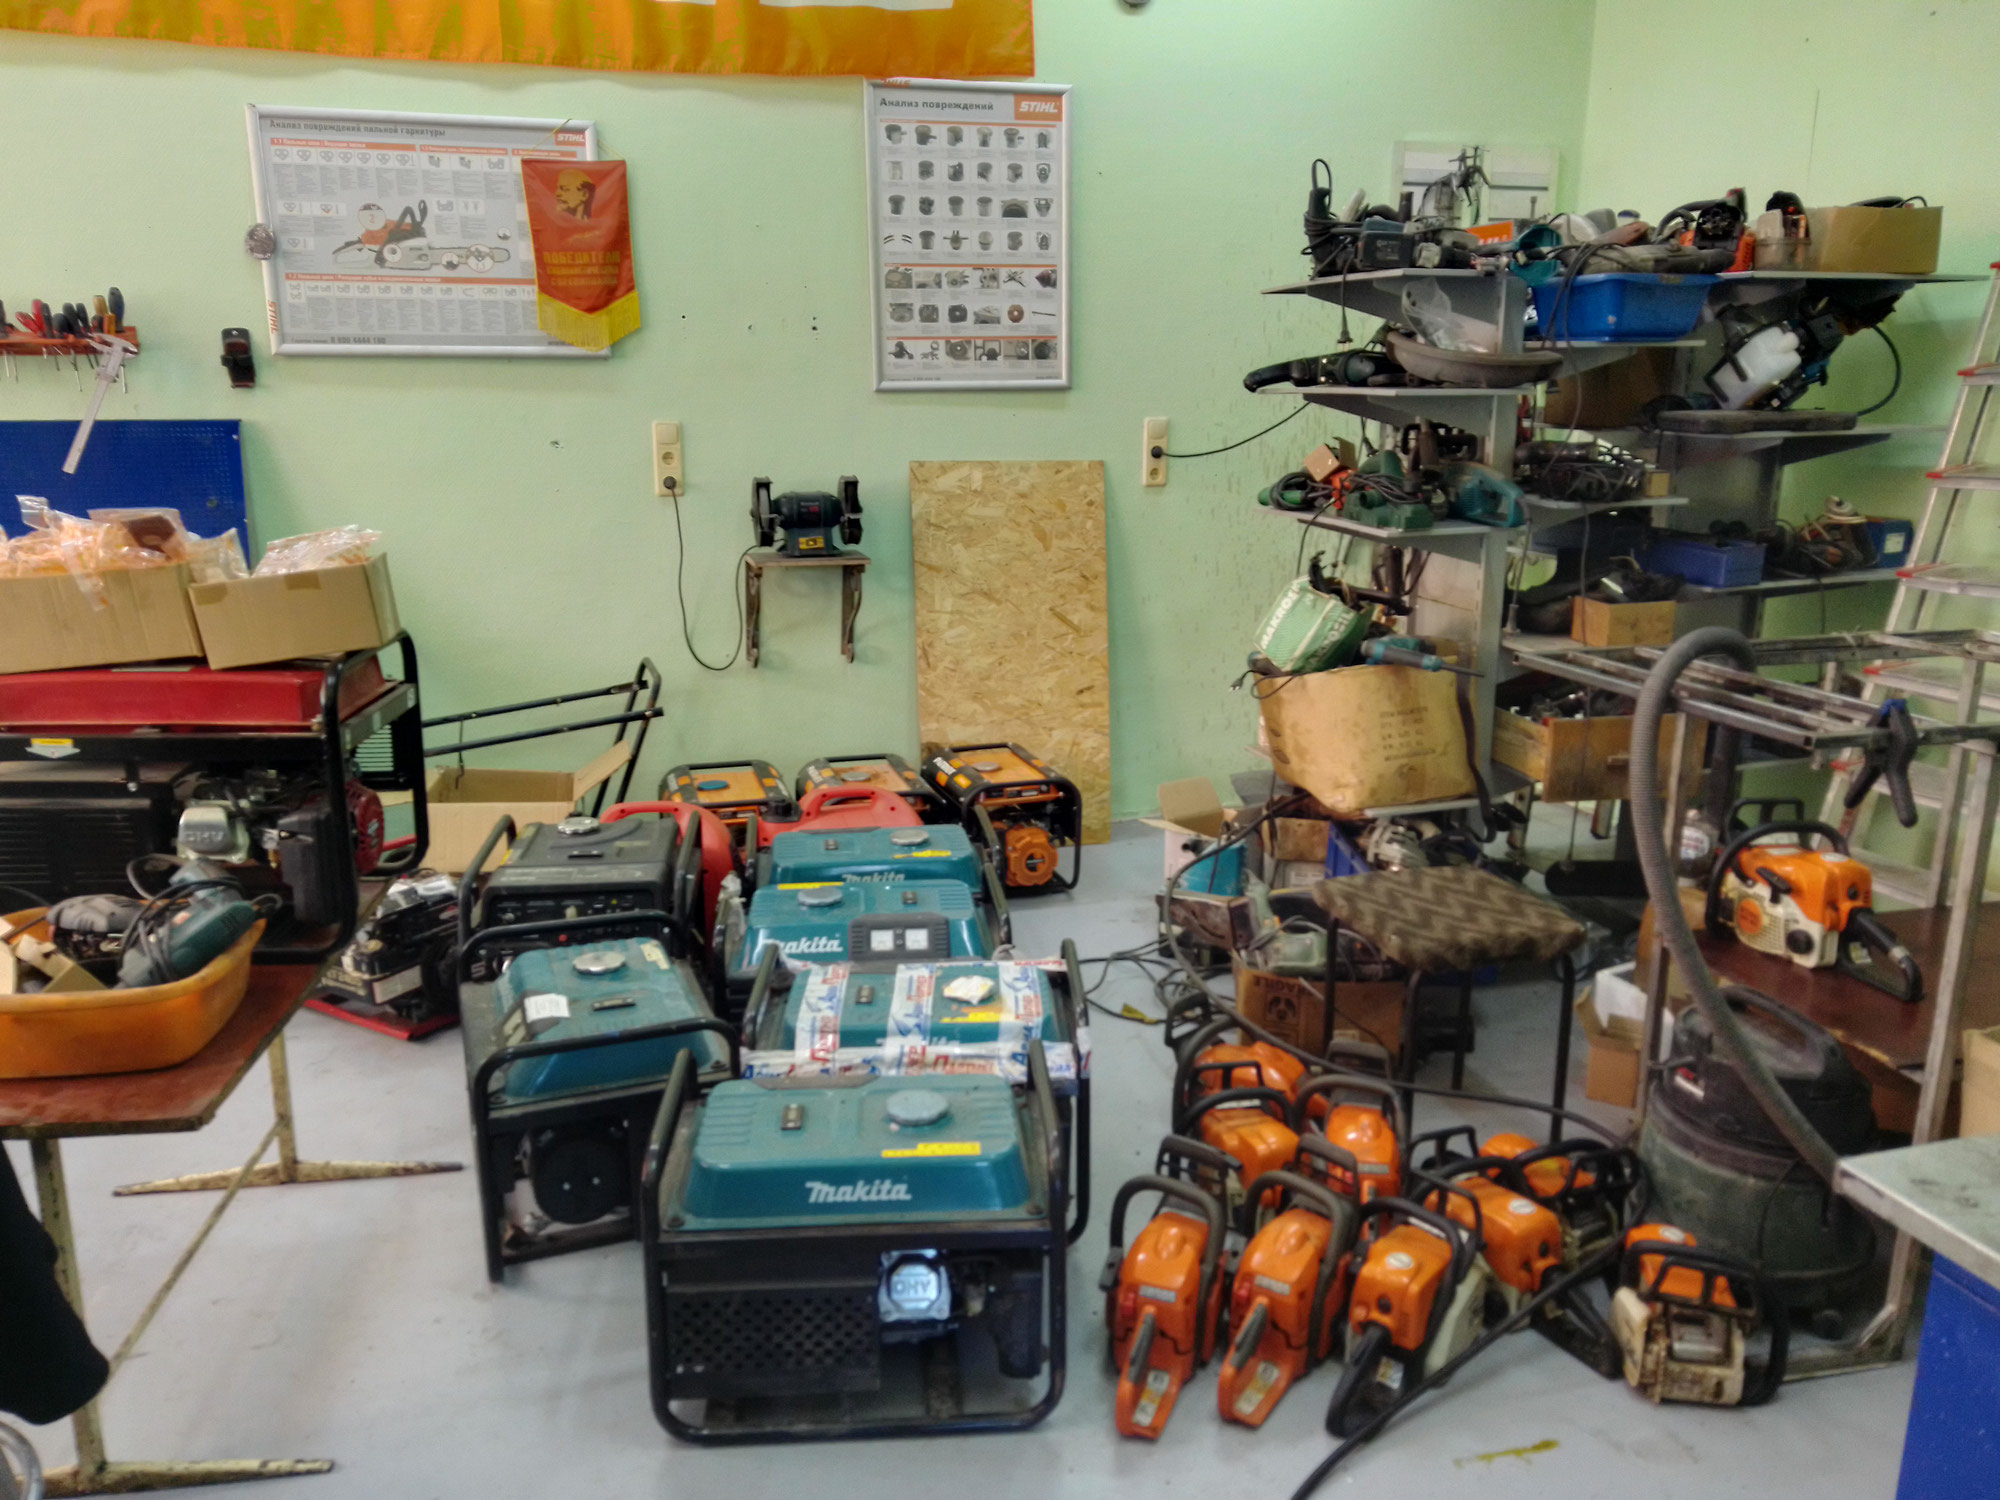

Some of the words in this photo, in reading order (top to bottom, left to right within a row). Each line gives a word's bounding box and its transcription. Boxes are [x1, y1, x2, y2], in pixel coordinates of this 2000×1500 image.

[880, 98, 919, 108] Анализ
[922, 100, 994, 111] повреждений
[1019, 101, 1058, 113] STIHL
[270, 120, 301, 129] Анализ
[303, 122, 362, 133] повреждений
[363, 126, 399, 135] пильной
[400, 128, 446, 137] гарнитуры
[557, 133, 585, 142] STIHL
[268, 299, 279, 335] STIHL
[842, 872, 905, 883] makita
[804, 1179, 912, 1203] makita
